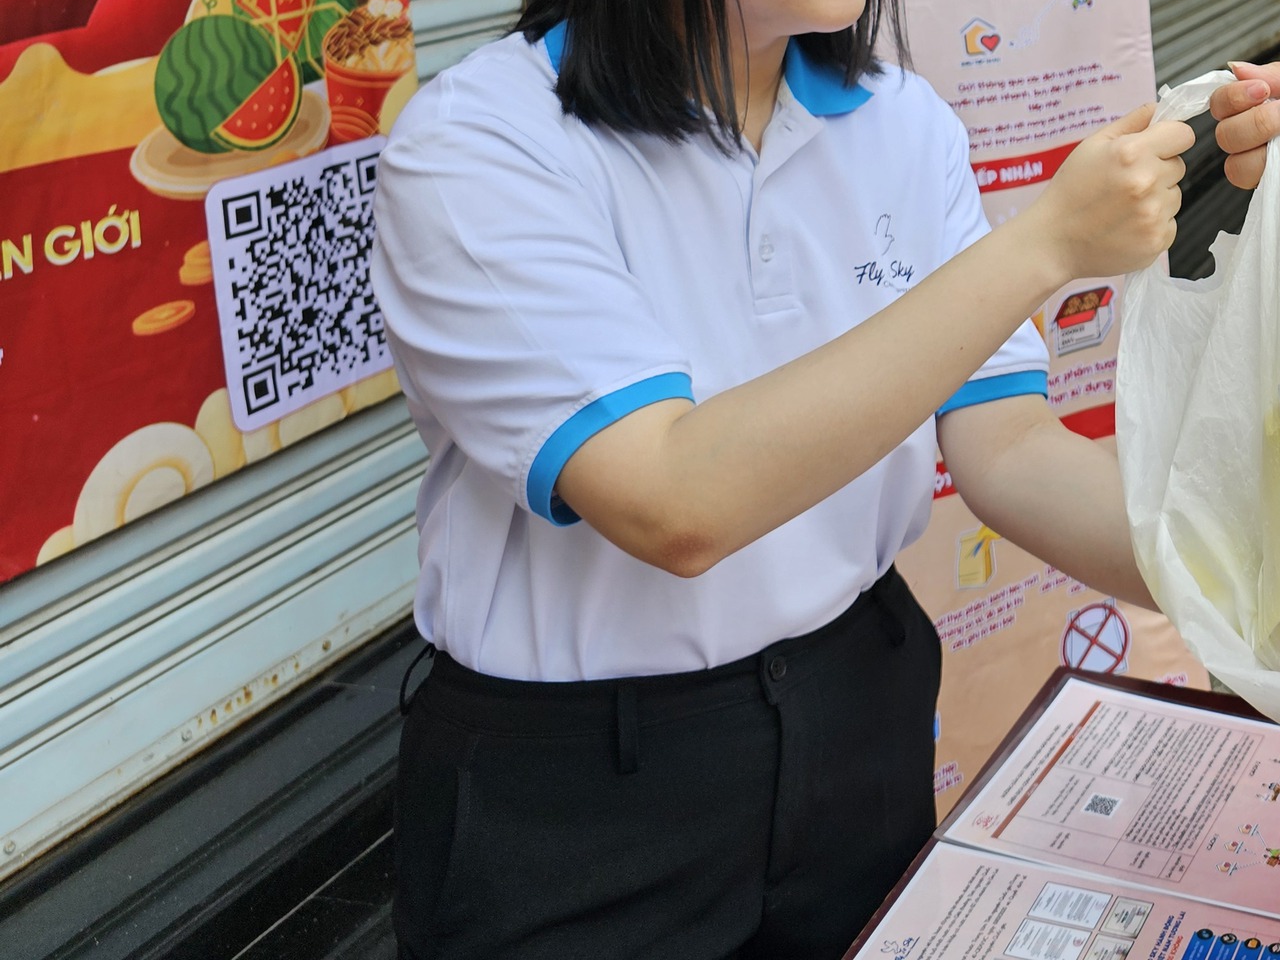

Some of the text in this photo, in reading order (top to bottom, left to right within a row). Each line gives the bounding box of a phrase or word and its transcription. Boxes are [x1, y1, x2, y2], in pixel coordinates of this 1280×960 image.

[976, 160, 1043, 187] ẾP NHẬN
[0, 204, 143, 281] N GIỚI
[854, 260, 914, 285] Fly Sky
